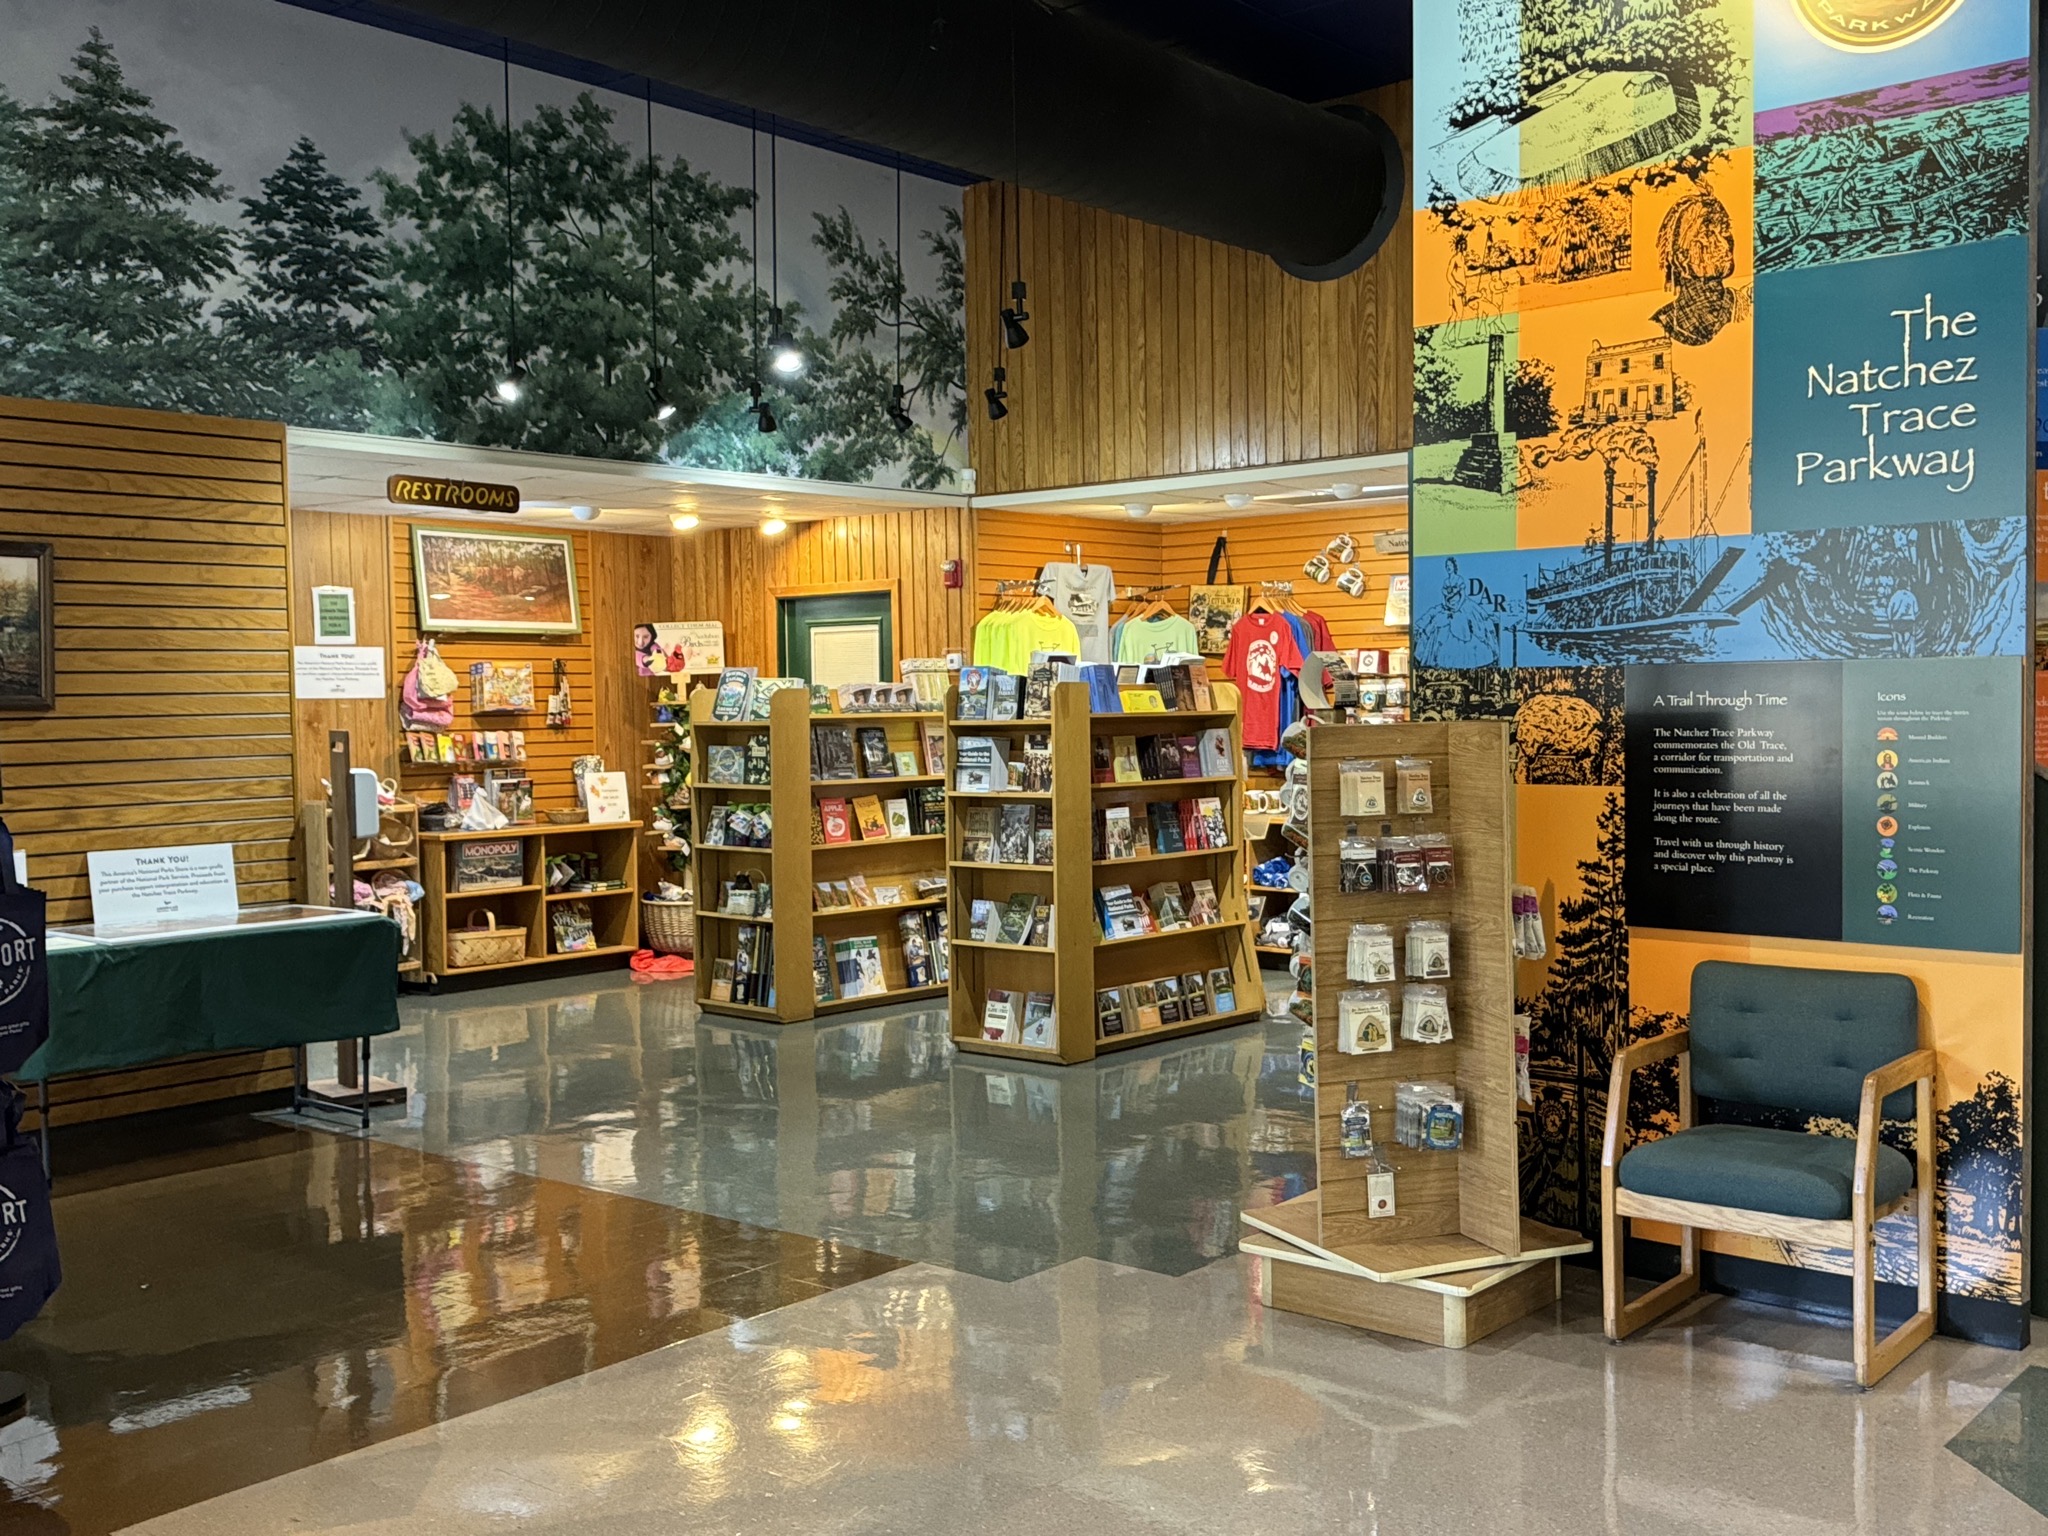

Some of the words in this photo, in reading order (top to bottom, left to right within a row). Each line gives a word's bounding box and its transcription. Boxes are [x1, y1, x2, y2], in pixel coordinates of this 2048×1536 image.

[1890, 293, 1978, 344] The
[1807, 343, 1978, 399] Natchez
[1848, 402, 1977, 436] Trace
[1796, 434, 1975, 492] Parkway
[396, 480, 515, 508] RESTROOMS
[1653, 695, 1665, 706] A
[1667, 691, 1693, 706] Trail
[1696, 690, 1752, 711] Through
[1755, 693, 1788, 705] Time
[1877, 692, 1906, 701] Icons
[1653, 728, 1671, 737] The
[1674, 728, 1709, 737] Natchez
[1710, 728, 1735, 737] Trace
[1737, 728, 1774, 739] Parkway
[1721, 741, 1735, 749] the
[1737, 740, 1755, 749] Old
[1760, 741, 1787, 750] Trace,
[1661, 753, 1696, 761] corridor
[1698, 753, 1711, 761] for
[1713, 753, 1774, 764] transportation
[1777, 753, 1794, 762] and
[1653, 766, 1723, 774] communication.
[1654, 789, 1660, 797] It
[1663, 789, 1670, 797] is
[1672, 789, 1688, 798] also
[1697, 789, 1745, 799] celebration
[1748, 790, 1759, 800] of
[1760, 791, 1770, 800] all
[1772, 791, 1787, 800] the
[1652, 801, 1690, 812] journeys
[1692, 802, 1709, 811] that
[1711, 802, 1731, 811] have
[1733, 803, 1755, 812] been
[1757, 804, 1782, 813] made
[1653, 813, 1677, 824] along
[1679, 814, 1692, 822] the
[1695, 815, 1721, 823] route.
[465, 843, 517, 857] MONOPOLY
[1654, 837, 1680, 847] Travel
[1681, 838, 1702, 847] with
[1716, 839, 1751, 852] through
[1753, 841, 1785, 853] history
[135, 856, 165, 865] THANK
[167, 855, 190, 864] YOU!
[1653, 850, 1669, 858] and
[1671, 850, 1706, 860] discover
[1708, 852, 1727, 863] why
[1729, 852, 1745, 862] this
[1747, 854, 1784, 866] pathway
[1786, 855, 1794, 864] is
[1661, 862, 1688, 873] special
[1691, 863, 1715, 874] place.
